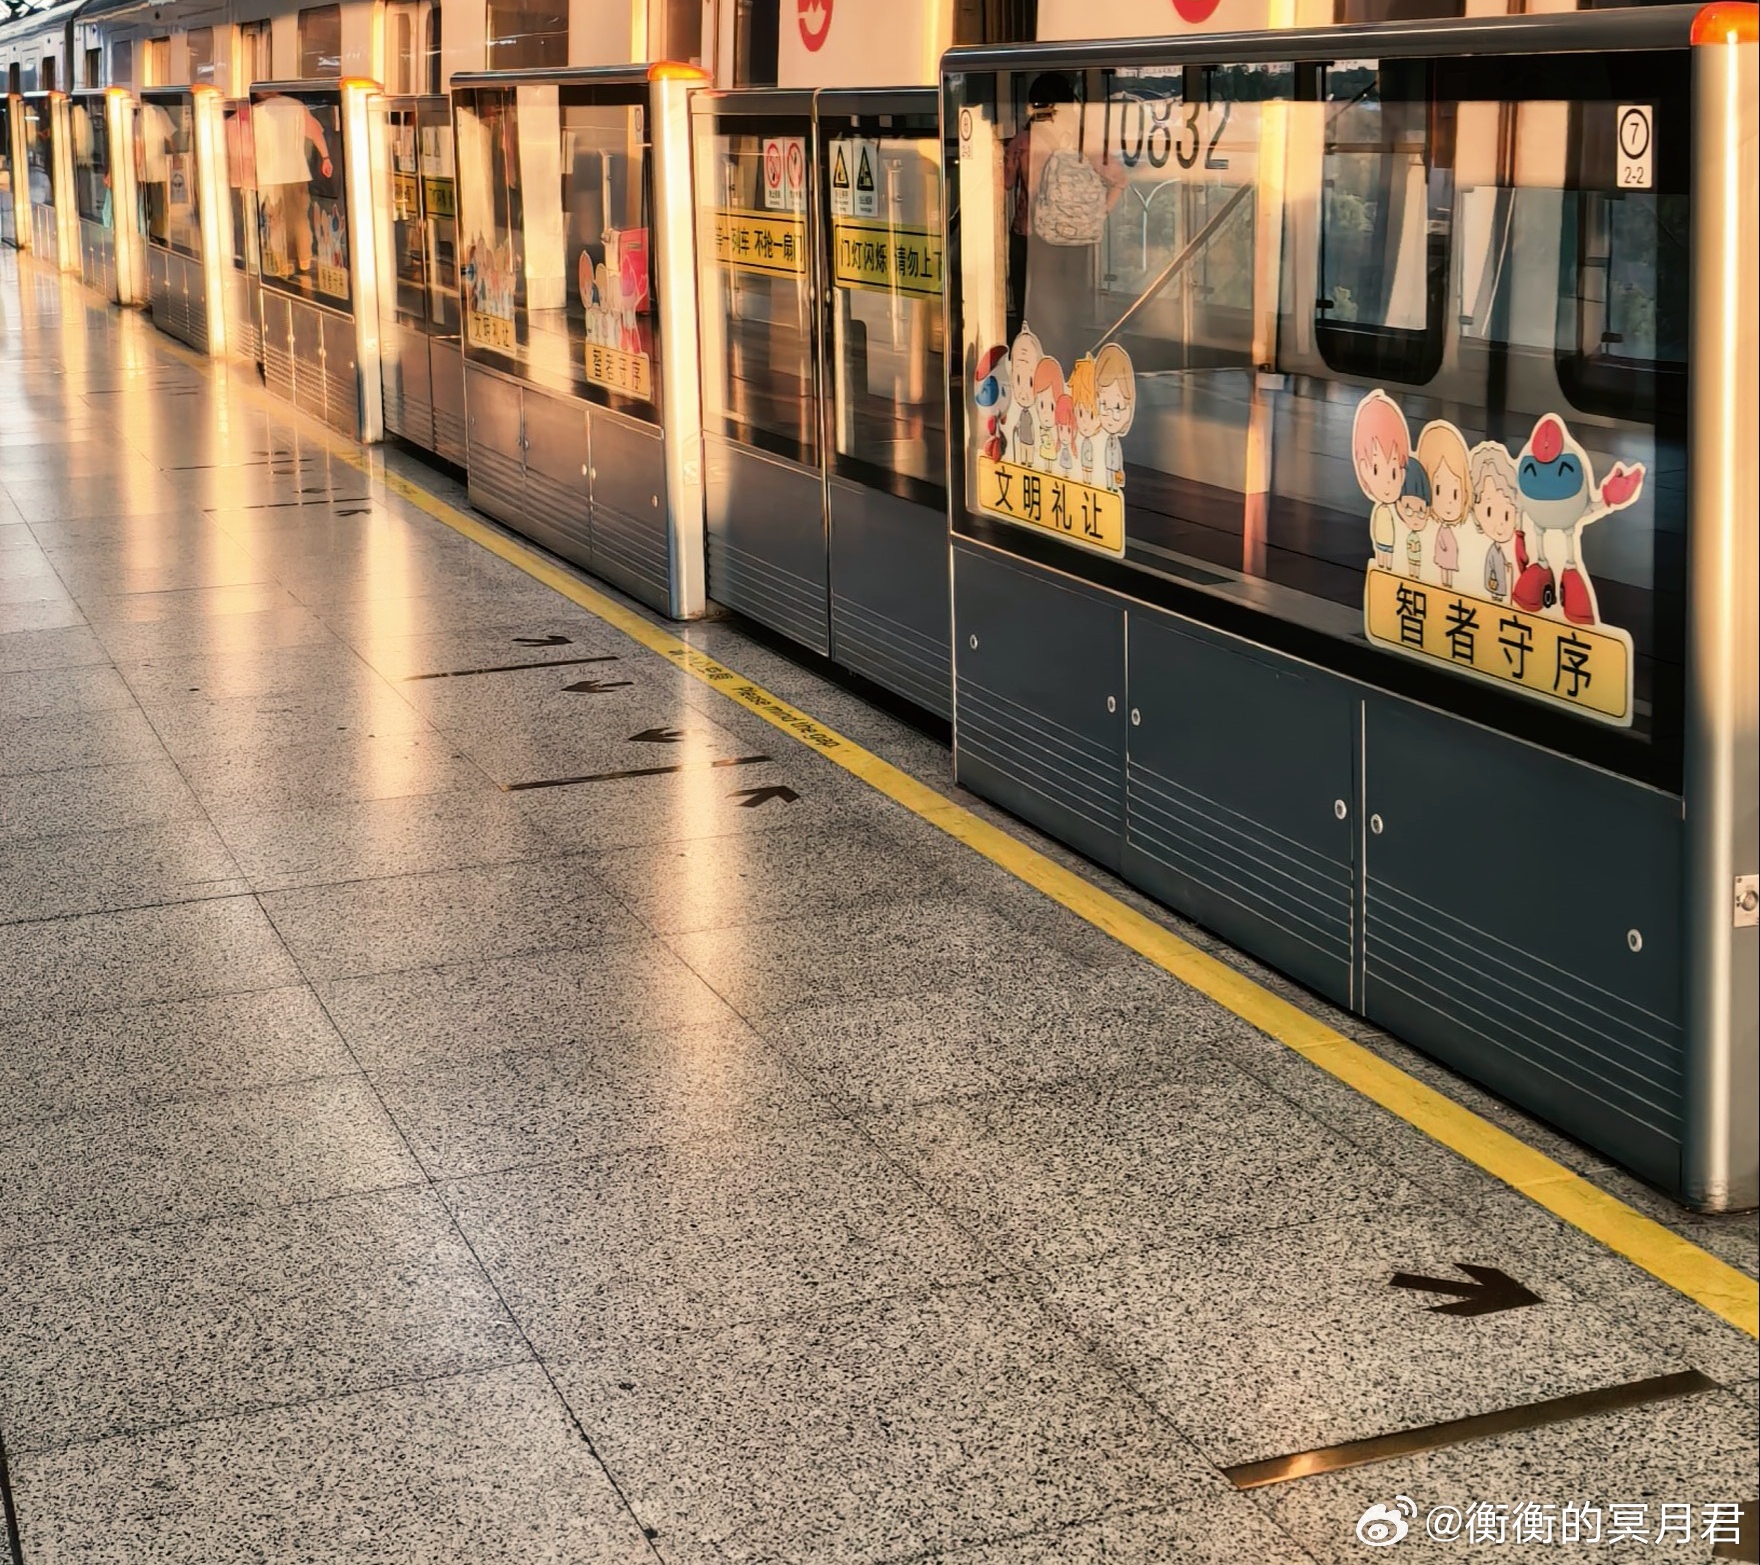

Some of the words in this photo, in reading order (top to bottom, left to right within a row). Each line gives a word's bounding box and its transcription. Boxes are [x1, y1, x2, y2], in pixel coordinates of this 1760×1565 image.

[1629, 122, 1640, 145] 7
[1624, 166, 1645, 184] 2-2
[994, 466, 1104, 540] 文明礼让
[1396, 582, 1593, 698] 智者守序
